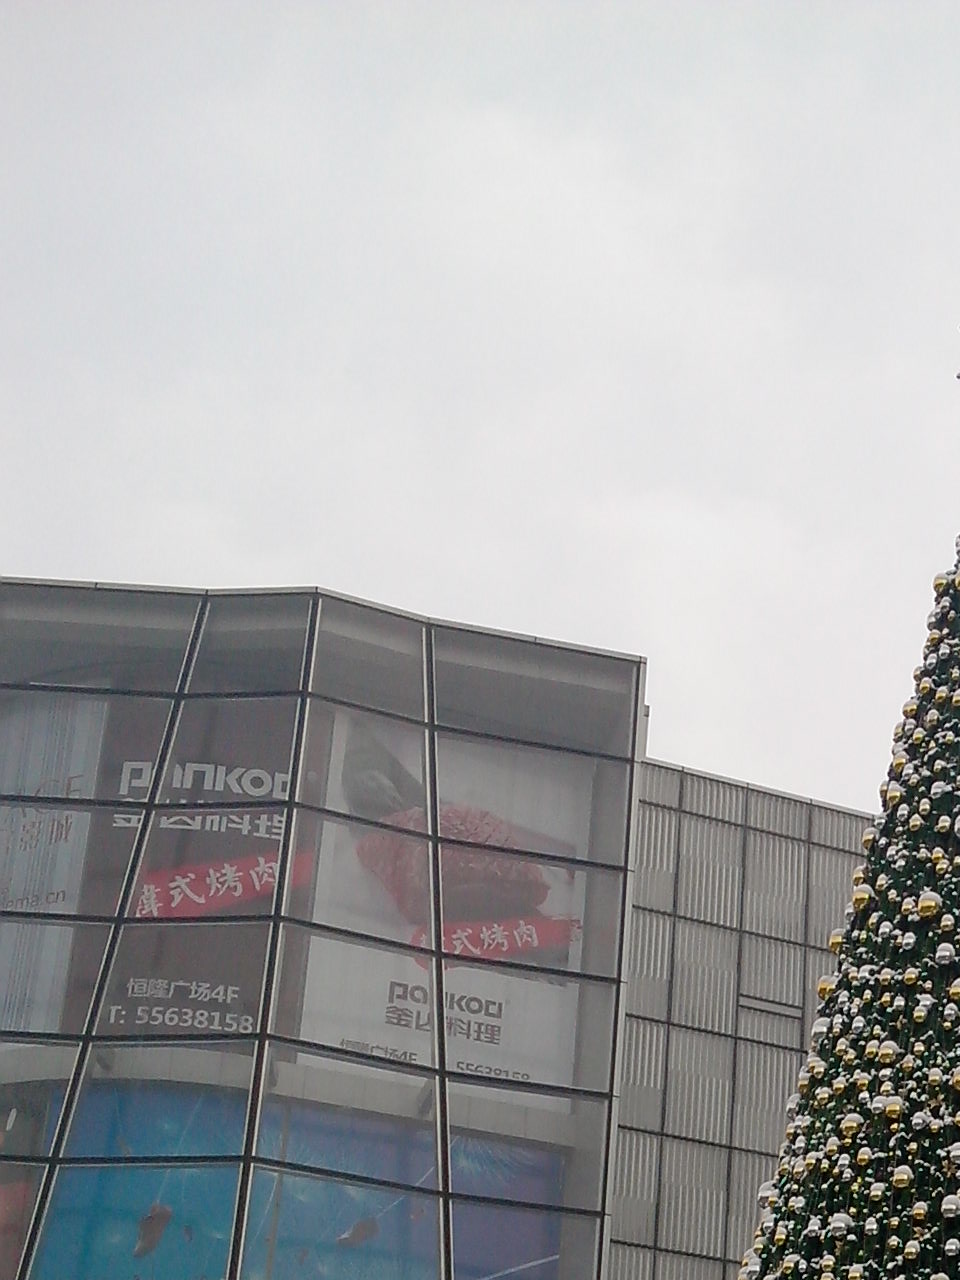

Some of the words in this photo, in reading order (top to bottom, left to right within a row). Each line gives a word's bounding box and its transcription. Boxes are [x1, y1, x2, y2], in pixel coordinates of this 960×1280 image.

[420, 920, 539, 955] 式烤肉
[127, 978, 240, 1004] 恒隆广场4F
[135, 1006, 254, 1034] 55638158
